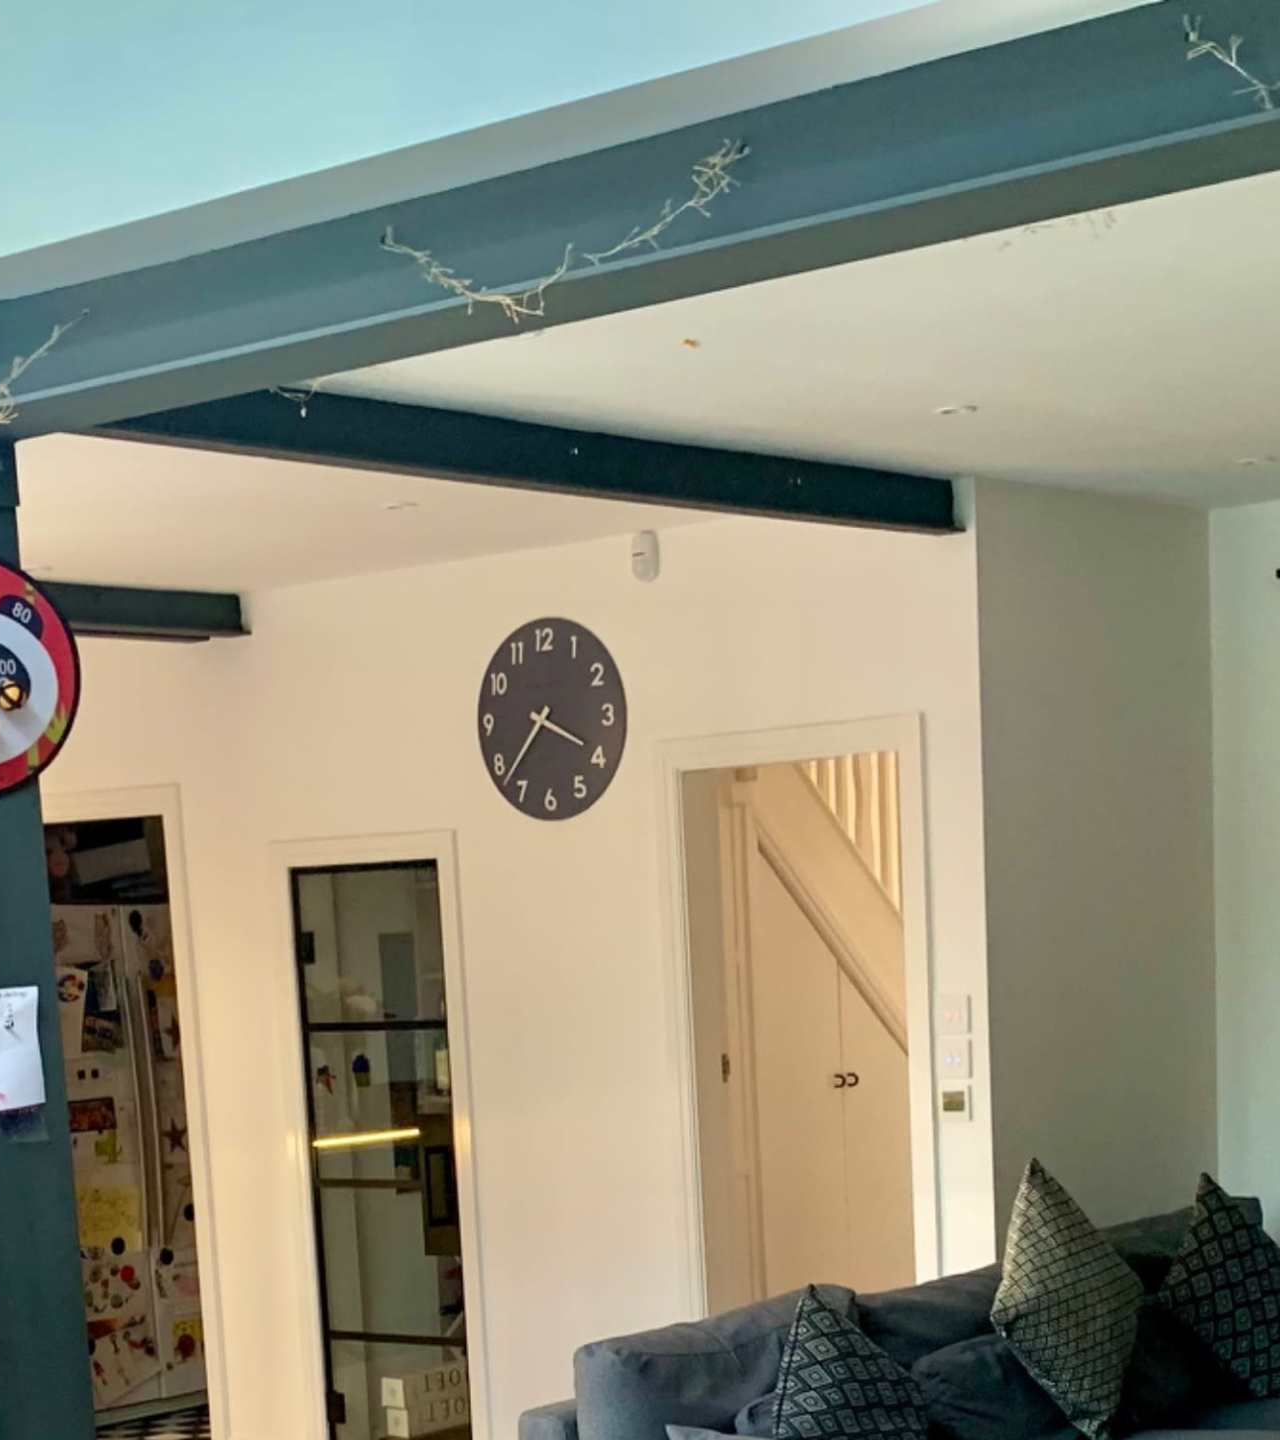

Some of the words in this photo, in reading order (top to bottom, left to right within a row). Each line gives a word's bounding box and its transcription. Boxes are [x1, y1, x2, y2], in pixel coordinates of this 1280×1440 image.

[12, 603, 32, 624] 80
[534, 628, 555, 652] 12
[570, 635, 577, 659] 1
[511, 642, 524, 665] 11
[490, 672, 508, 696] 10
[589, 663, 605, 687] 2
[482, 714, 494, 737] 9
[601, 703, 615, 726] 3
[493, 752, 505, 776] 8
[590, 745, 607, 769] 4
[516, 780, 528, 803] 7
[574, 776, 588, 798] 5
[544, 788, 557, 812] 6
